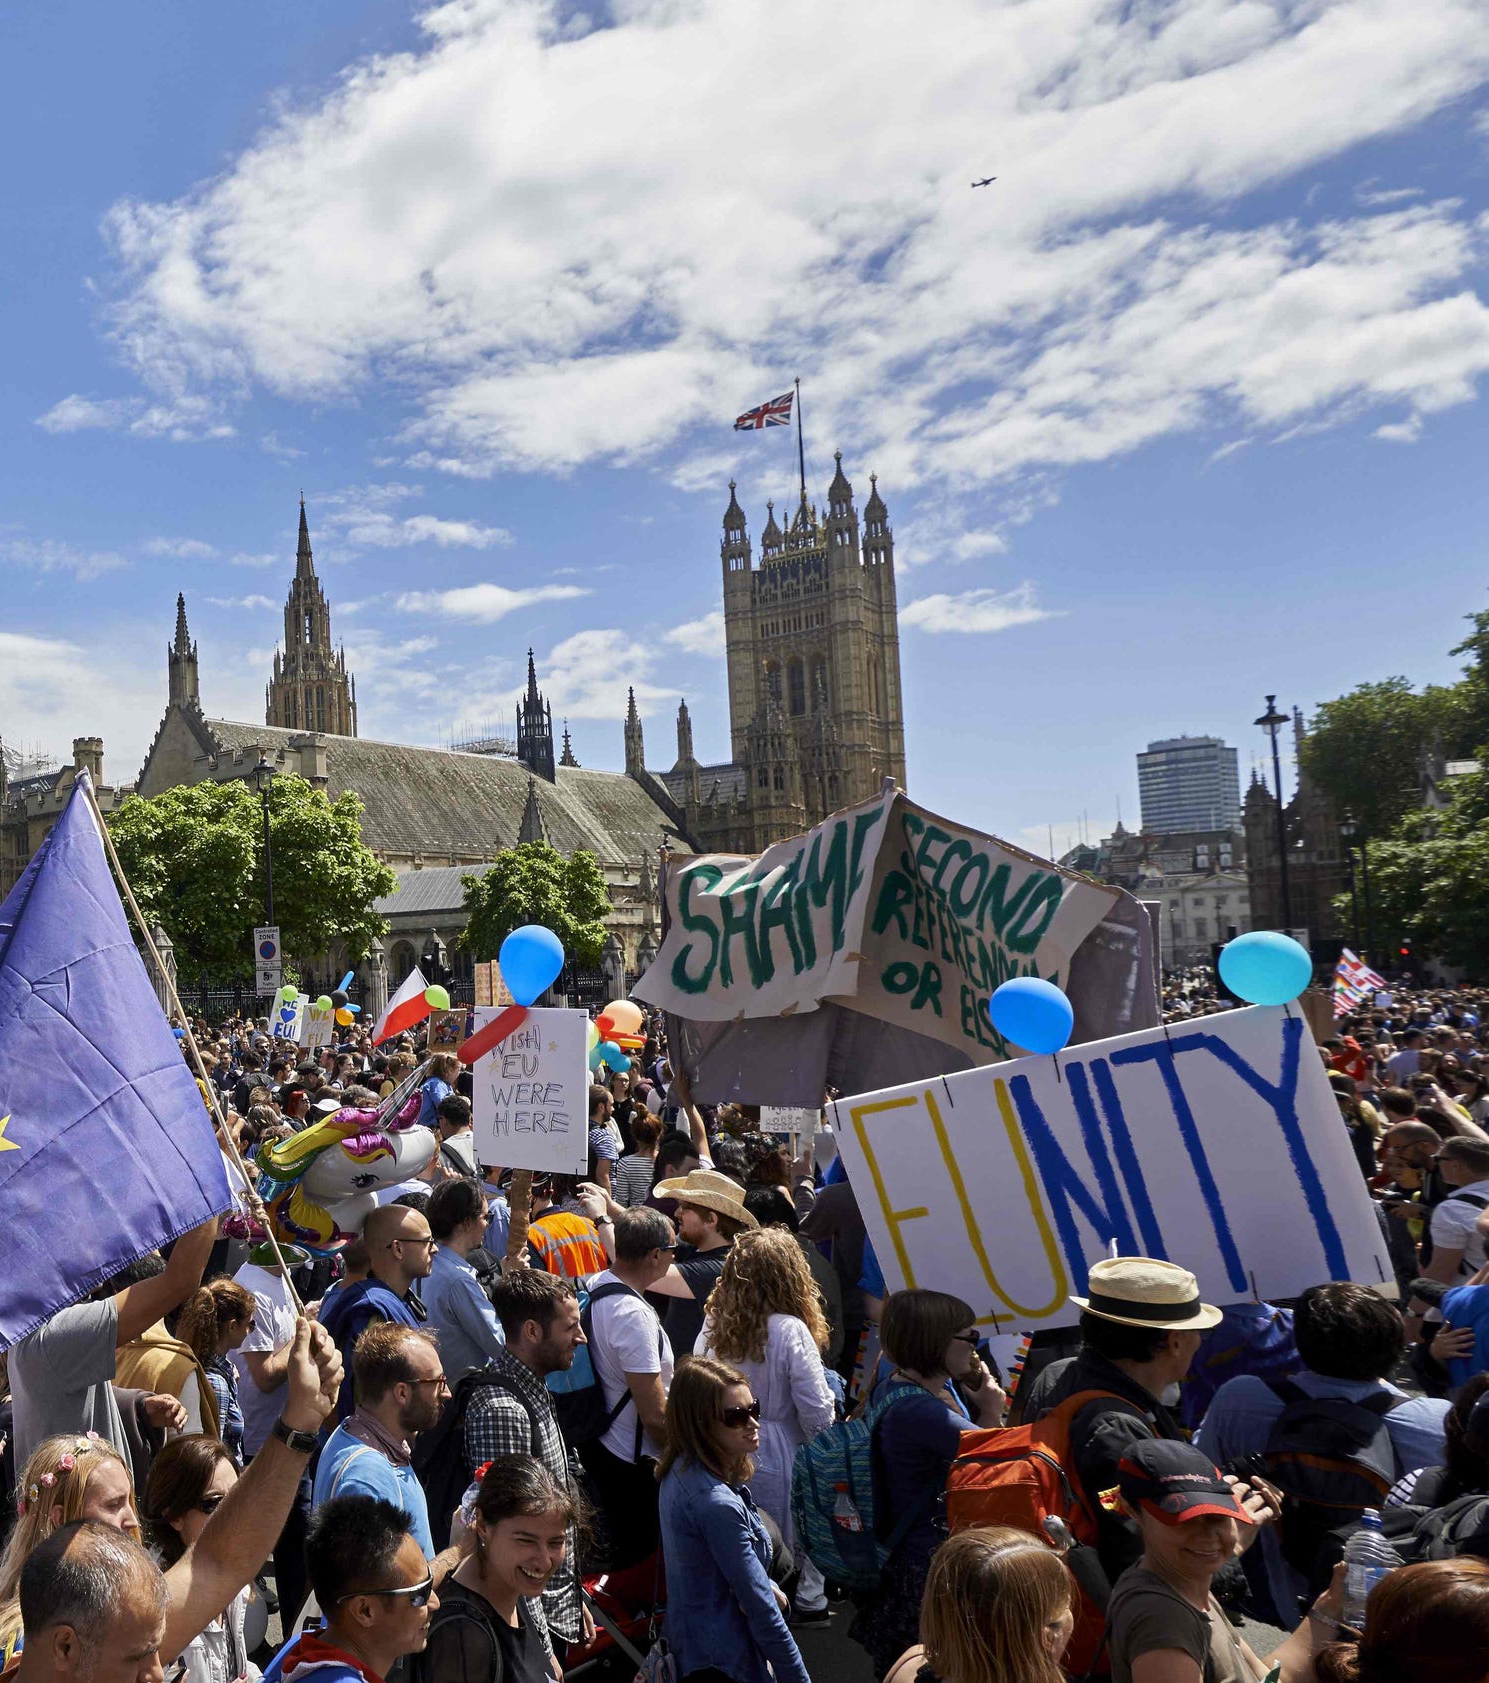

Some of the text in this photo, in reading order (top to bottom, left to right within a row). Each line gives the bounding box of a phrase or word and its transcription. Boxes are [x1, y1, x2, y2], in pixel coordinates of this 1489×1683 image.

[901, 812, 1063, 954] SECOND
[871, 870, 1059, 992] REFEREND
[881, 961, 942, 1018] OR
[274, 1022, 296, 1040] EU!
[961, 984, 1012, 1060] ELS
[502, 1053, 539, 1079] EU
[491, 1082, 565, 1108] WERE
[493, 1110, 569, 1137] HERE
